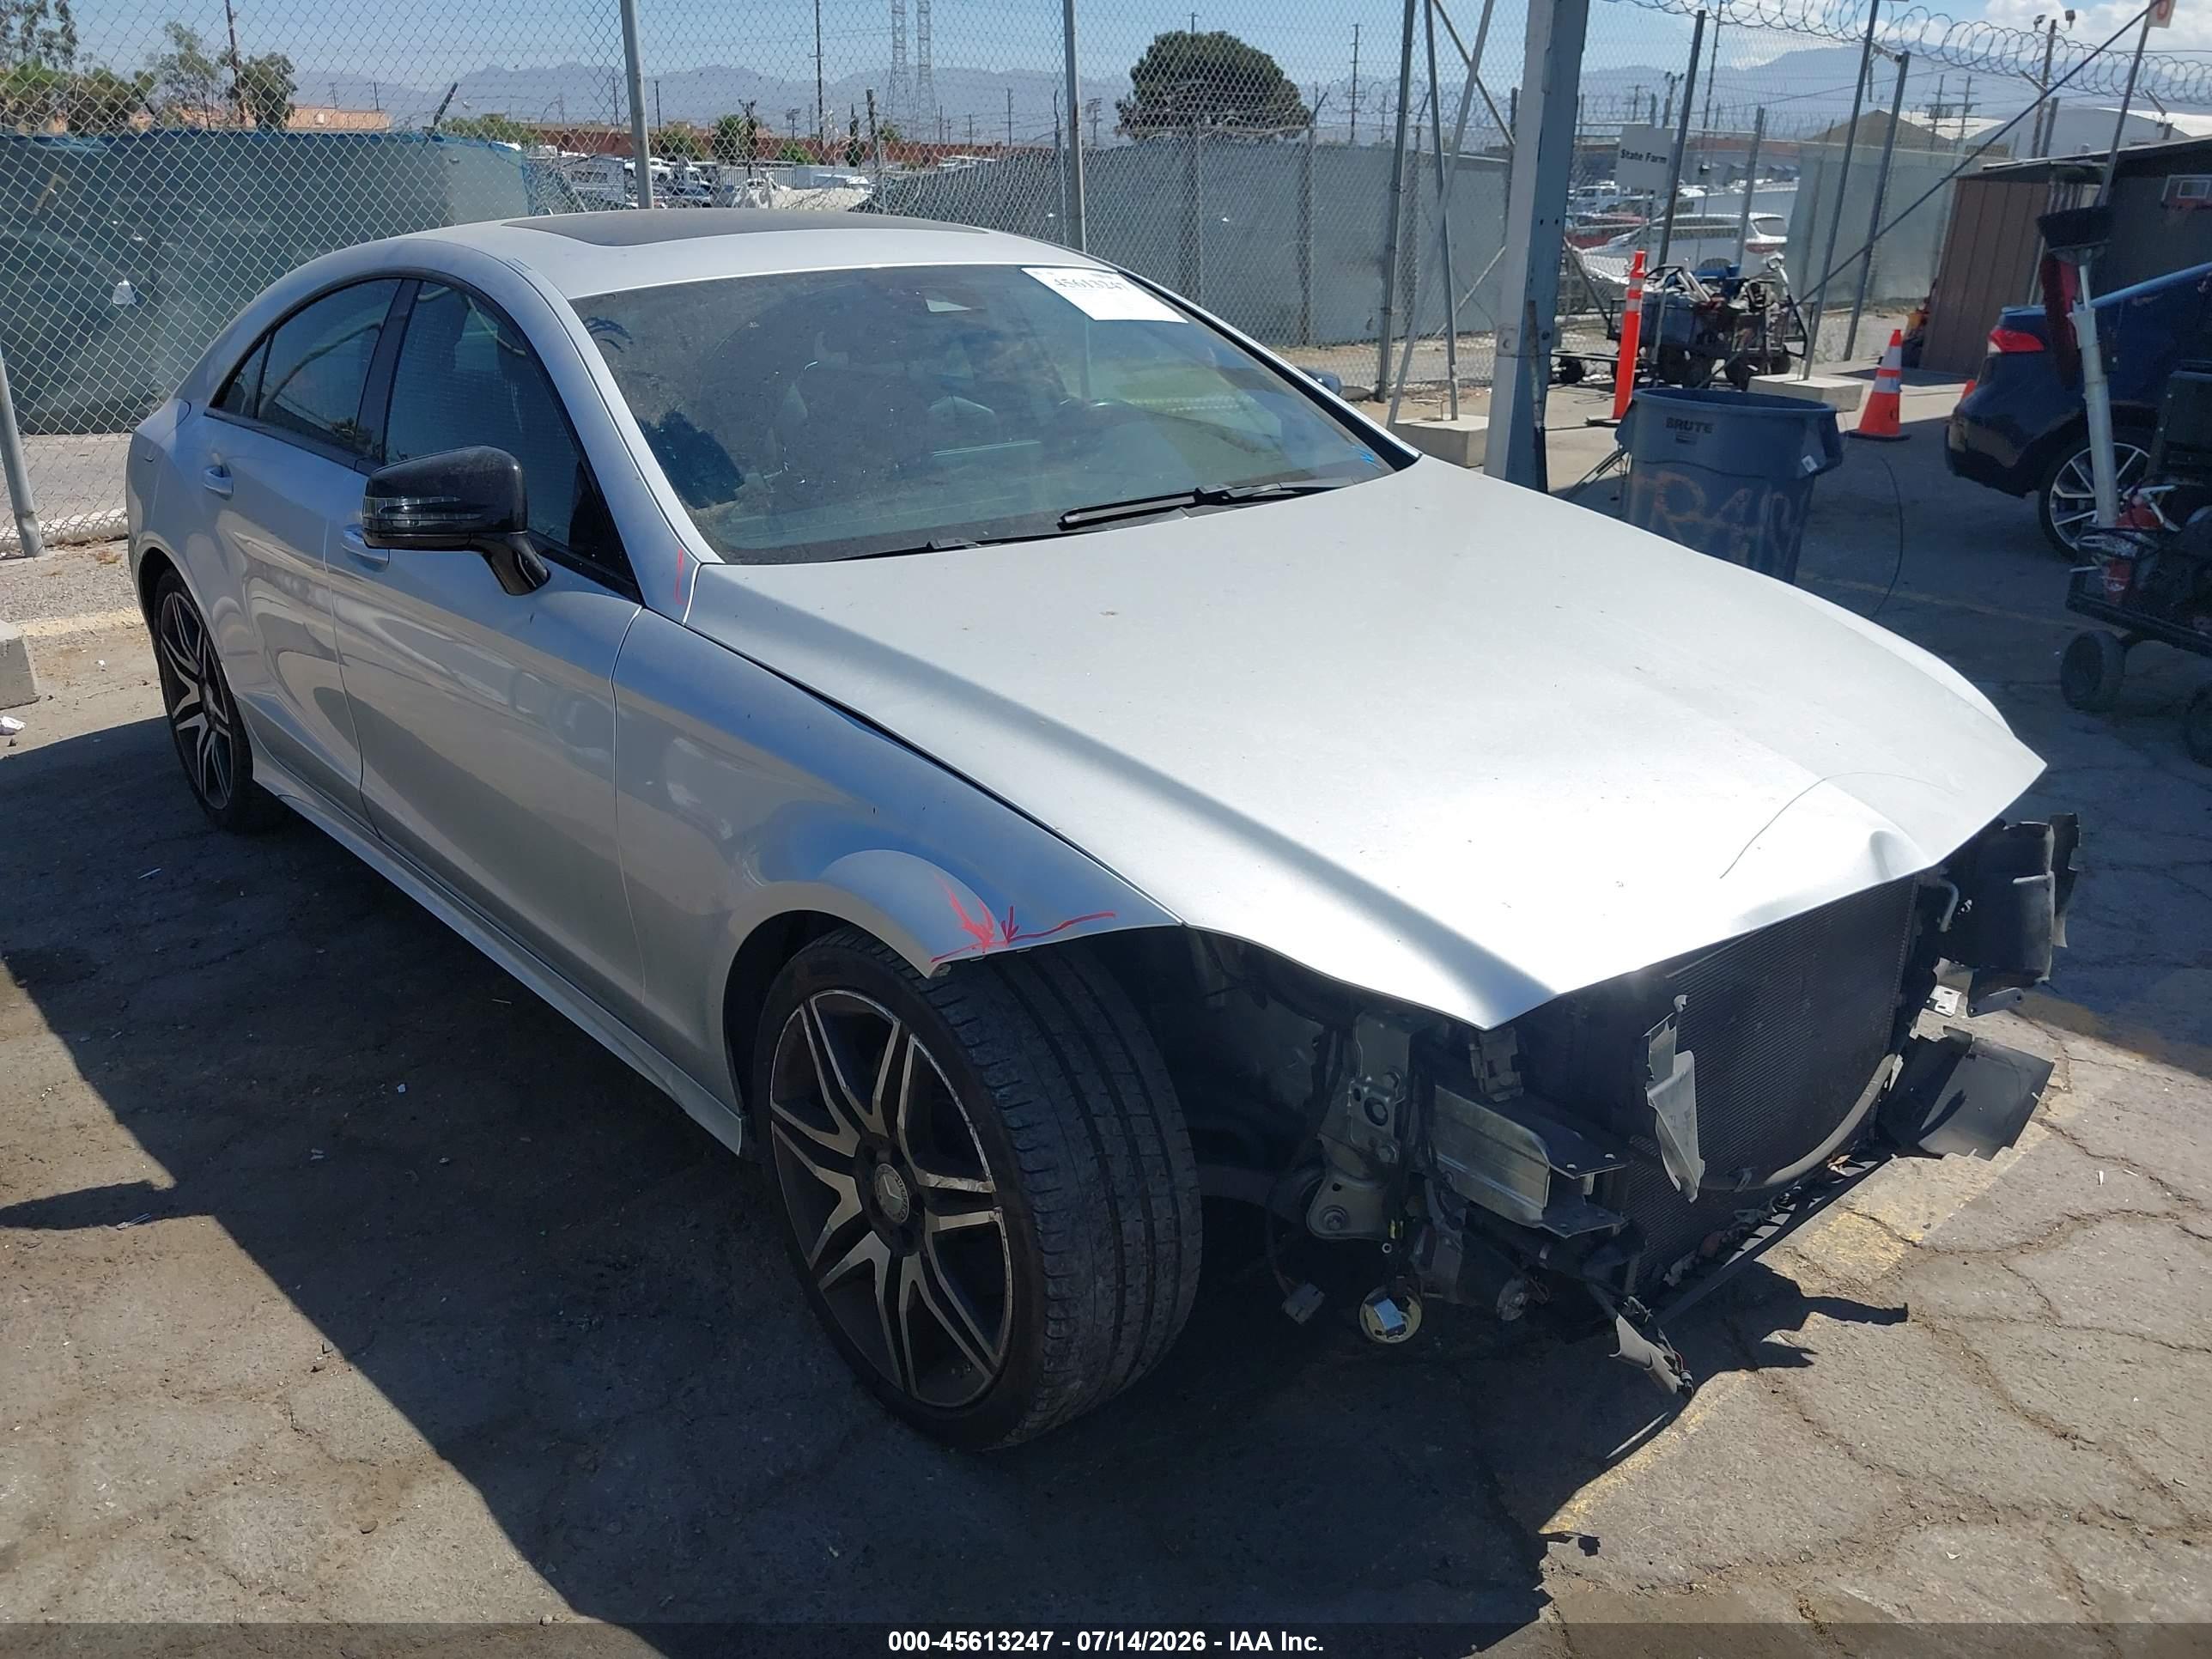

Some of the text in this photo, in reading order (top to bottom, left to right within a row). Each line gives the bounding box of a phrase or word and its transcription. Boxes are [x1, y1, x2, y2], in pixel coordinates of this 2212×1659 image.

[1620, 149, 1668, 164] State Farm
[1666, 417, 1715, 434] BRUTE
